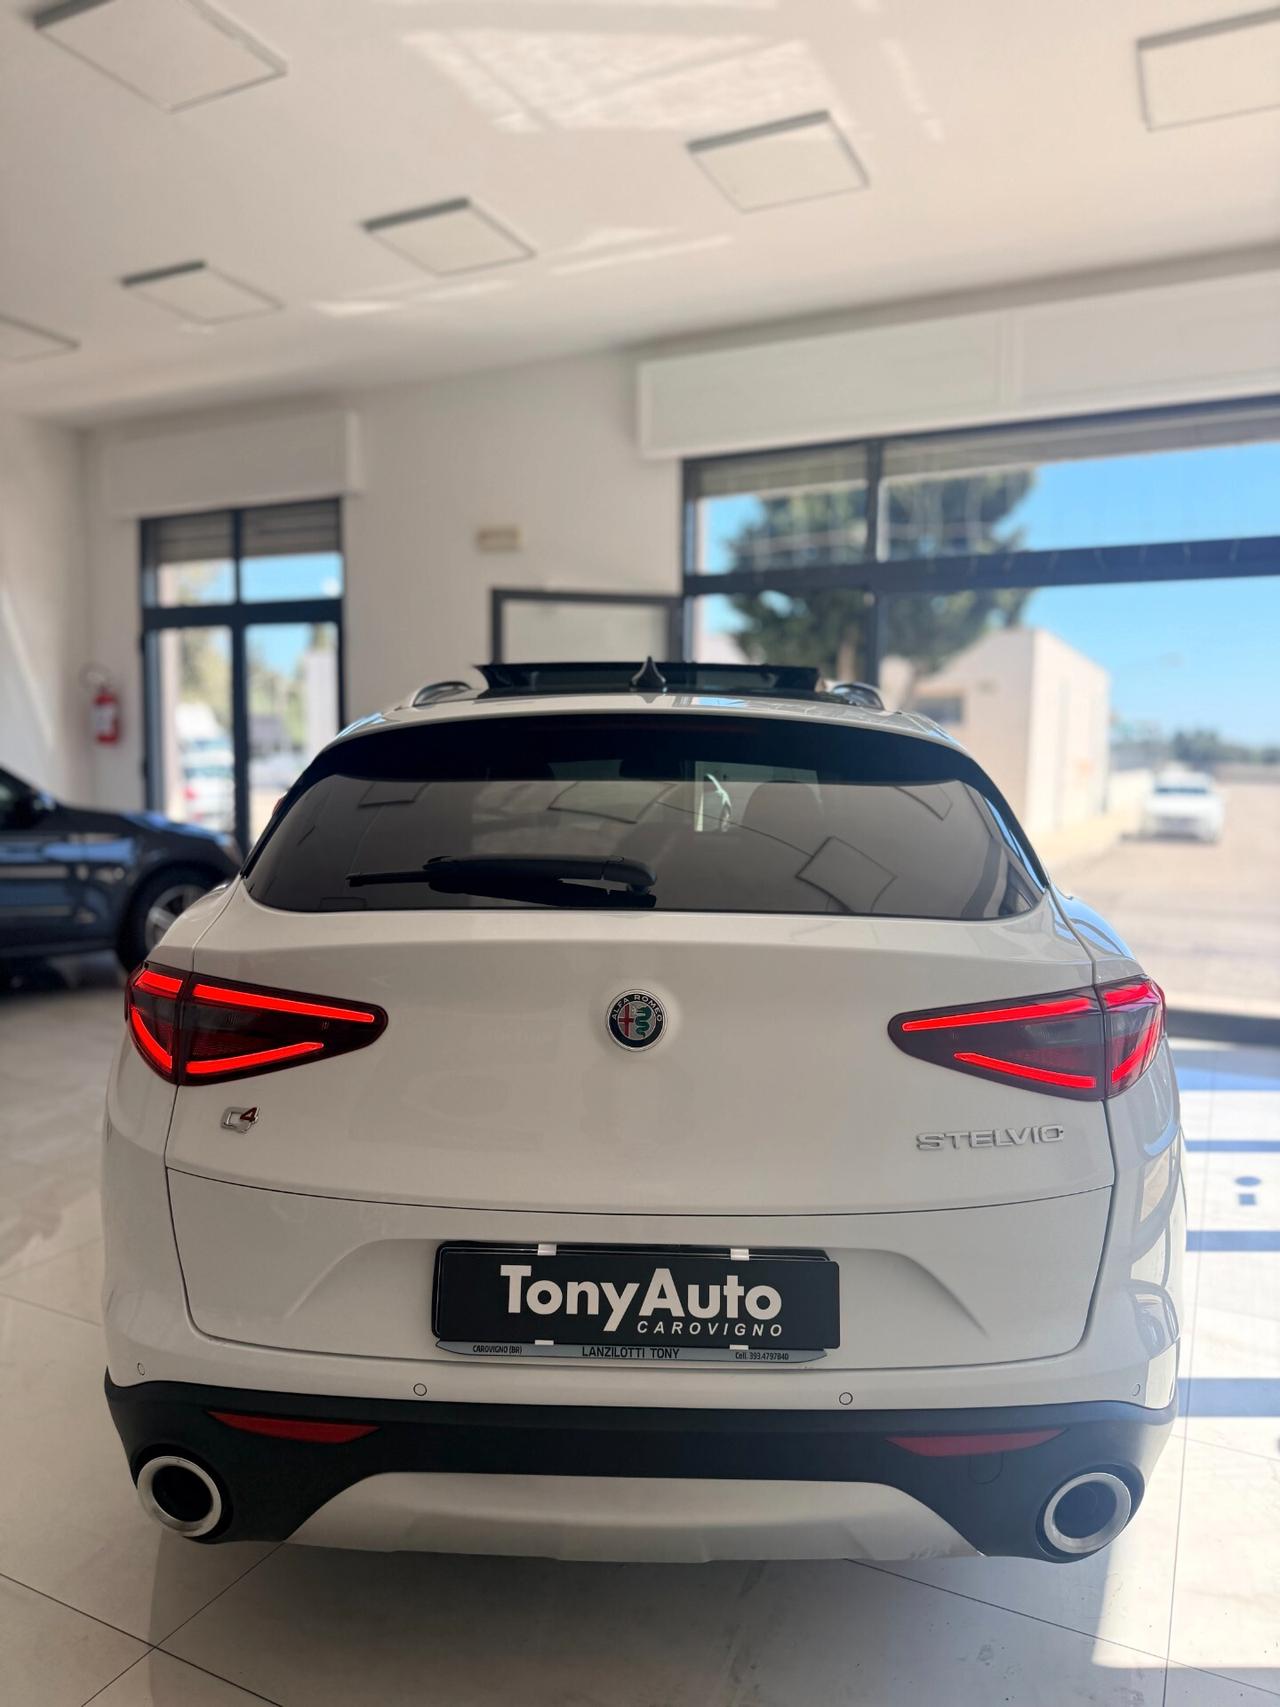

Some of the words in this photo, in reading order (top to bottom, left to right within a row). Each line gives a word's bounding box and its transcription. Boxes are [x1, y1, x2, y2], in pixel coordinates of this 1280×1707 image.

[612, 998, 629, 1020] ALFA
[634, 995, 662, 1022] ROMEO
[221, 1106, 259, 1133] Q4
[916, 1124, 1065, 1150] STELVIO
[500, 1264, 782, 1332] TonyAuto
[637, 1320, 782, 1337] CAROVIGNO
[472, 1344, 508, 1353] CAROVIGNO
[509, 1345, 522, 1354] (BR)
[582, 1346, 645, 1358] LANZILOTTI
[650, 1347, 680, 1359] TONY
